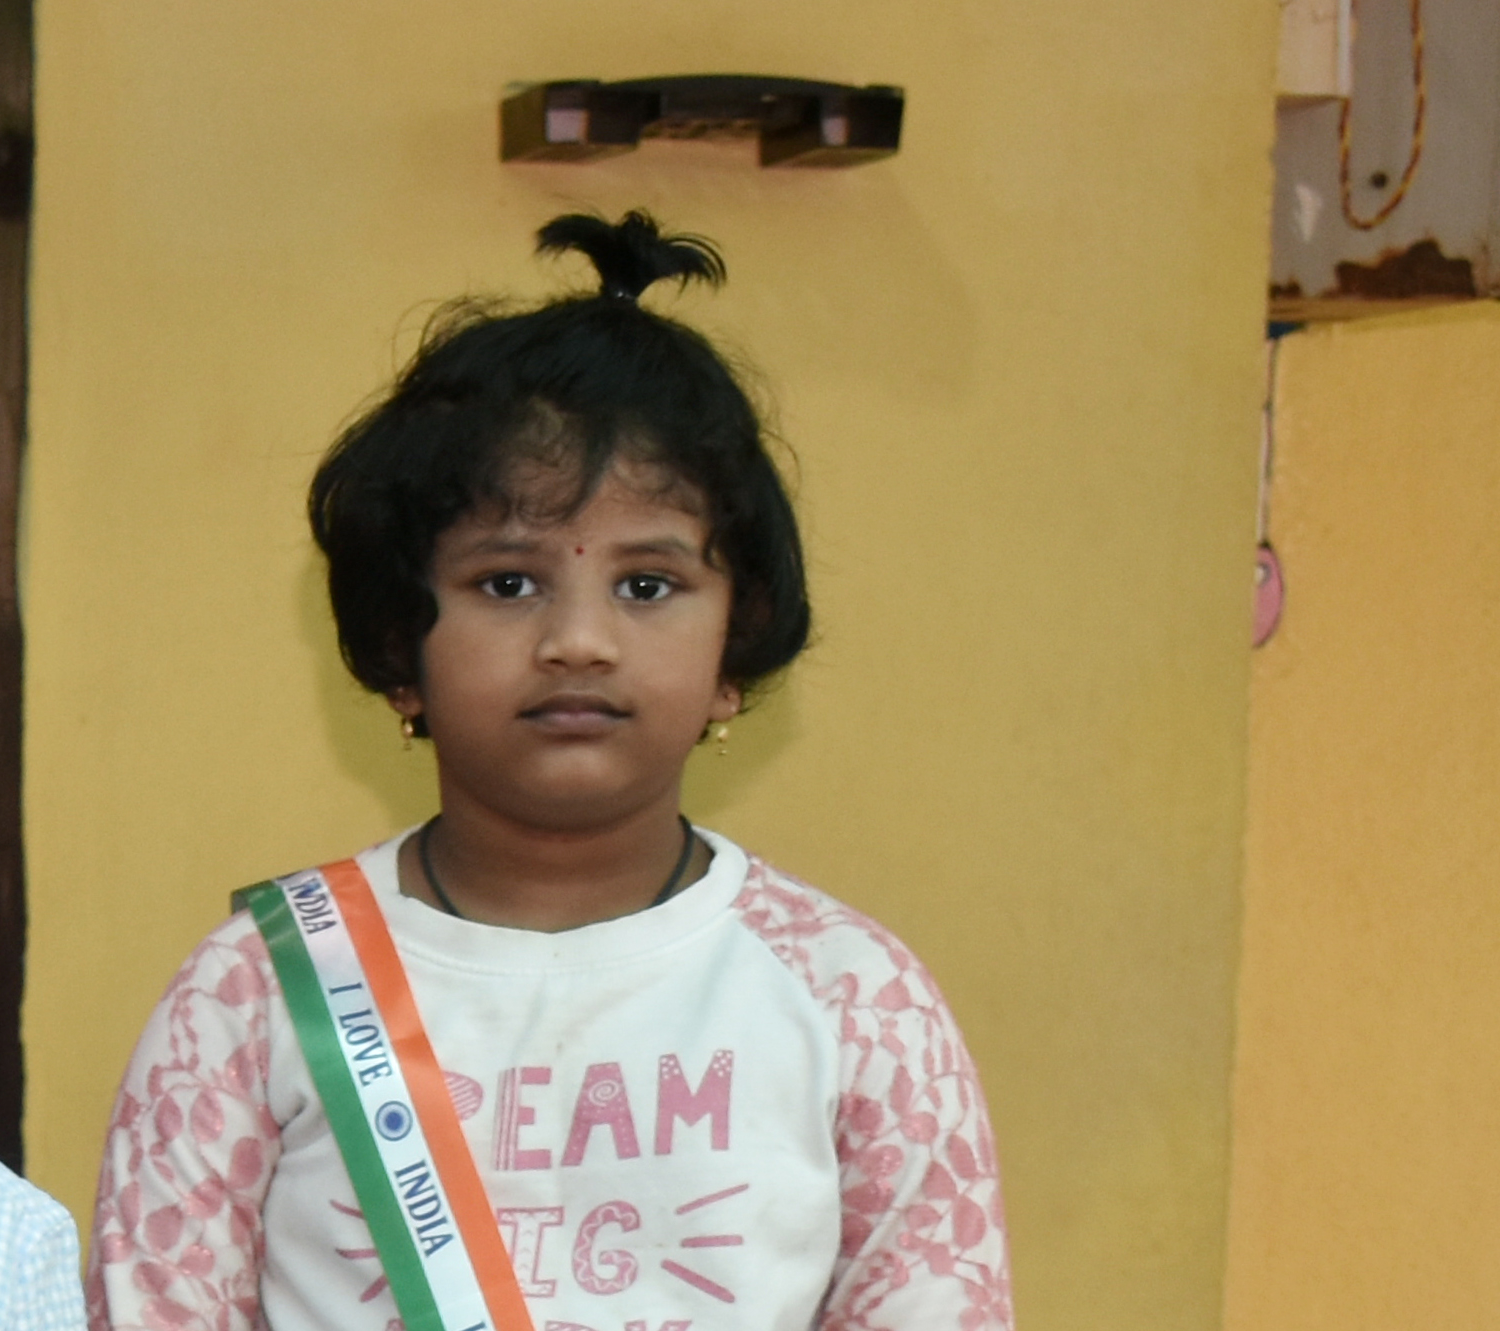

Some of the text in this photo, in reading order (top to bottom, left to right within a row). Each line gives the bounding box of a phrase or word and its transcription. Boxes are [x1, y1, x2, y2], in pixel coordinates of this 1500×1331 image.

[328, 983, 455, 1259] I LOVE INDIA
[445, 1049, 734, 1171] EAM
[493, 1200, 642, 1298] IG
